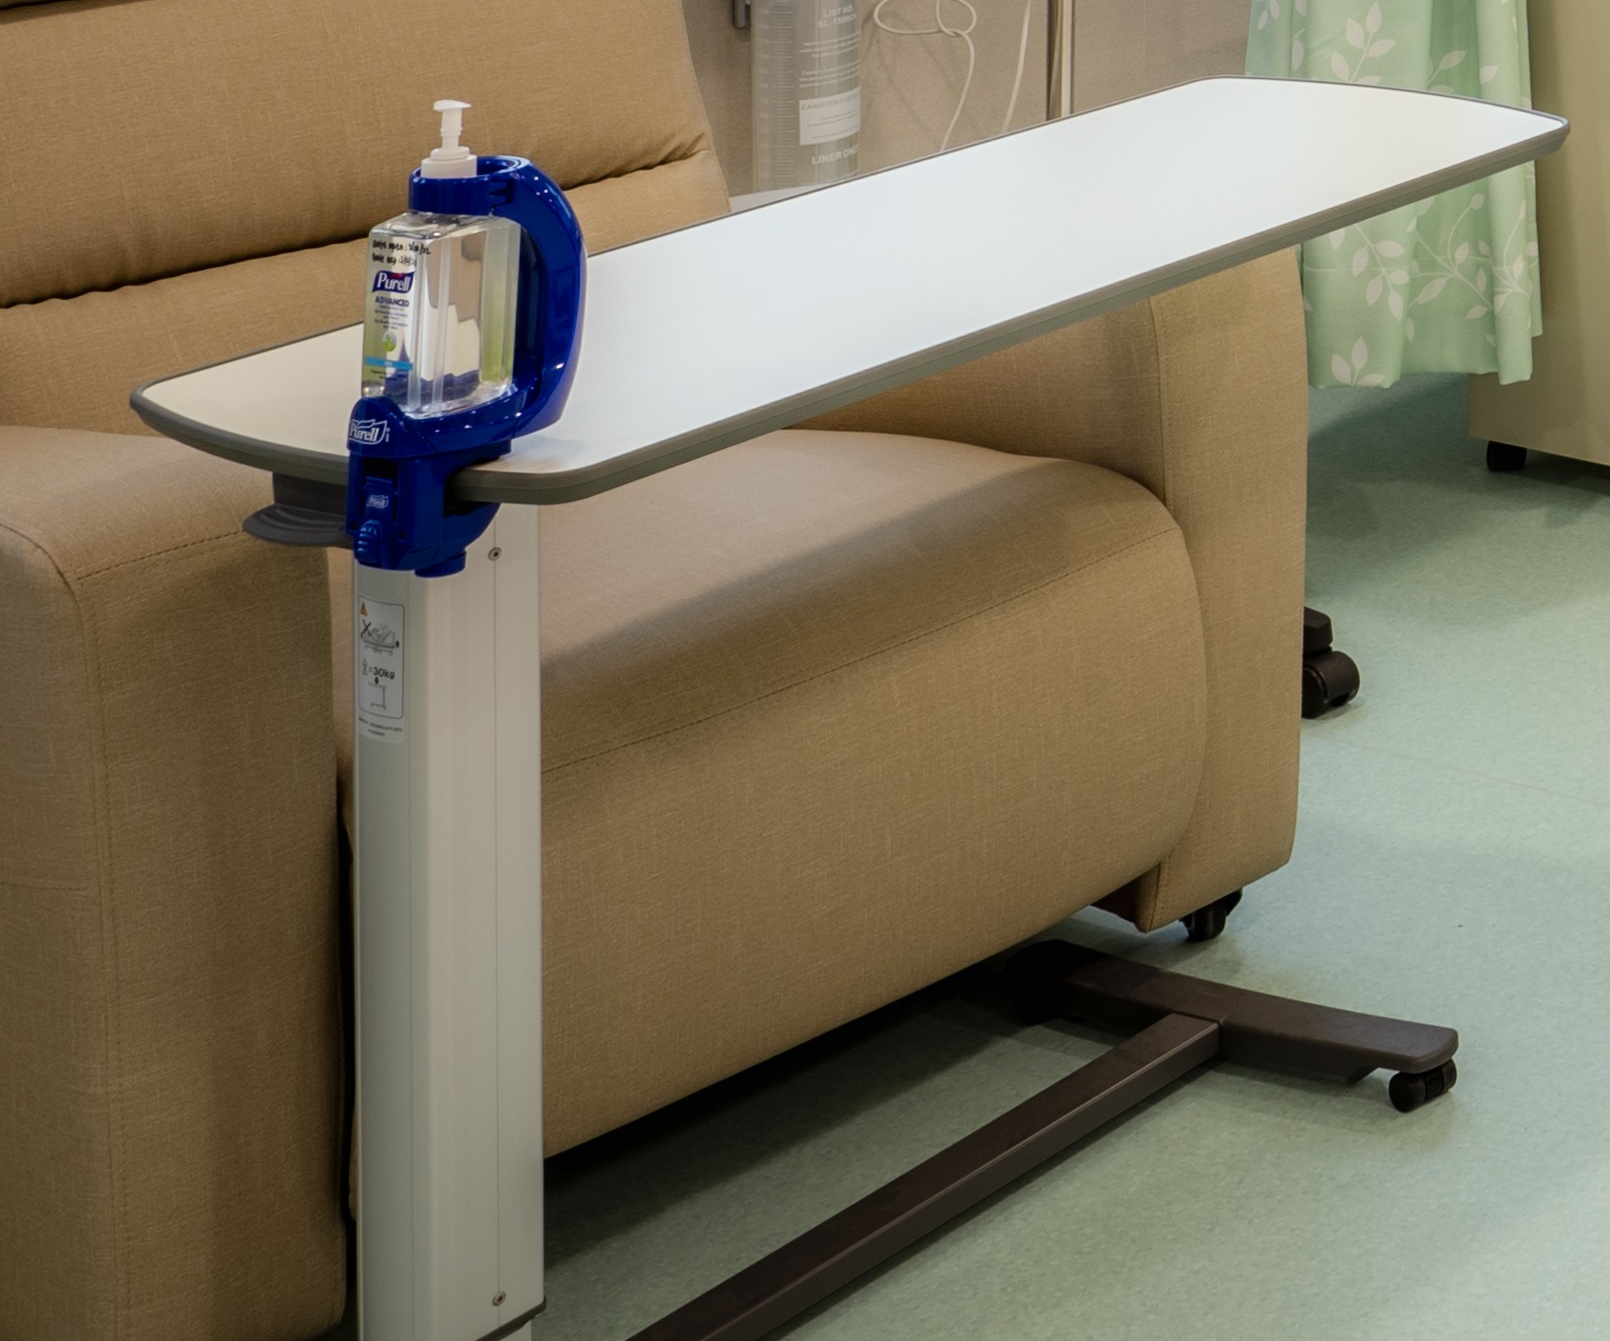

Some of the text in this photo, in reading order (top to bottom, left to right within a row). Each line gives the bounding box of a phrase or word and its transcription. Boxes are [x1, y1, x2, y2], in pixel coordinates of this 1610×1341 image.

[811, 151, 842, 165] LINER
[377, 272, 411, 292] Purell
[350, 422, 380, 442] Purell
